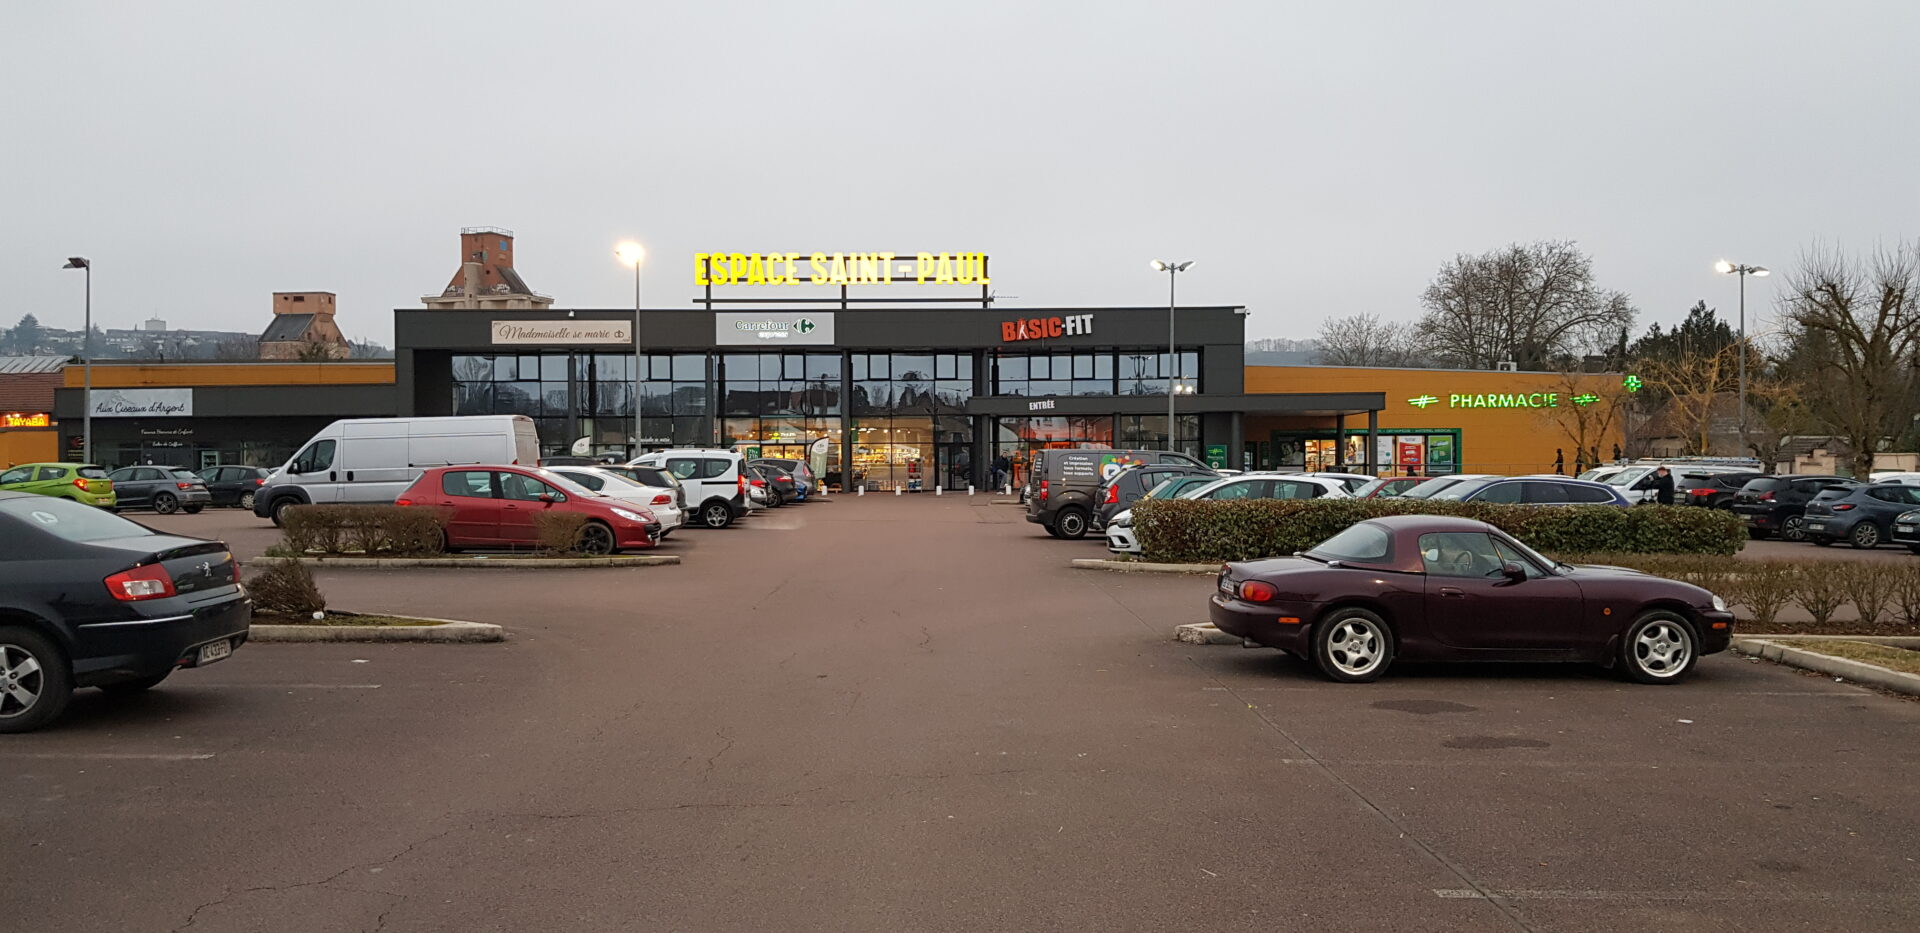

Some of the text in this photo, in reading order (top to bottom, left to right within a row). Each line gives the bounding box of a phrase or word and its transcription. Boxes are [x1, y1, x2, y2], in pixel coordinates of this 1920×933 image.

[694, 251, 991, 286] ESPACE SAINT-PAUL
[735, 319, 789, 331] Carrefour
[1002, 314, 1094, 342] BASIC-FIT
[499, 325, 610, 340] Mademoiselle se marie
[1029, 399, 1055, 411] ENTRÉE
[1449, 393, 1558, 408] PHARMACIE
[95, 402, 185, 415] Aux Ciseaux d'Argent
[7, 417, 45, 426] TAYABA
